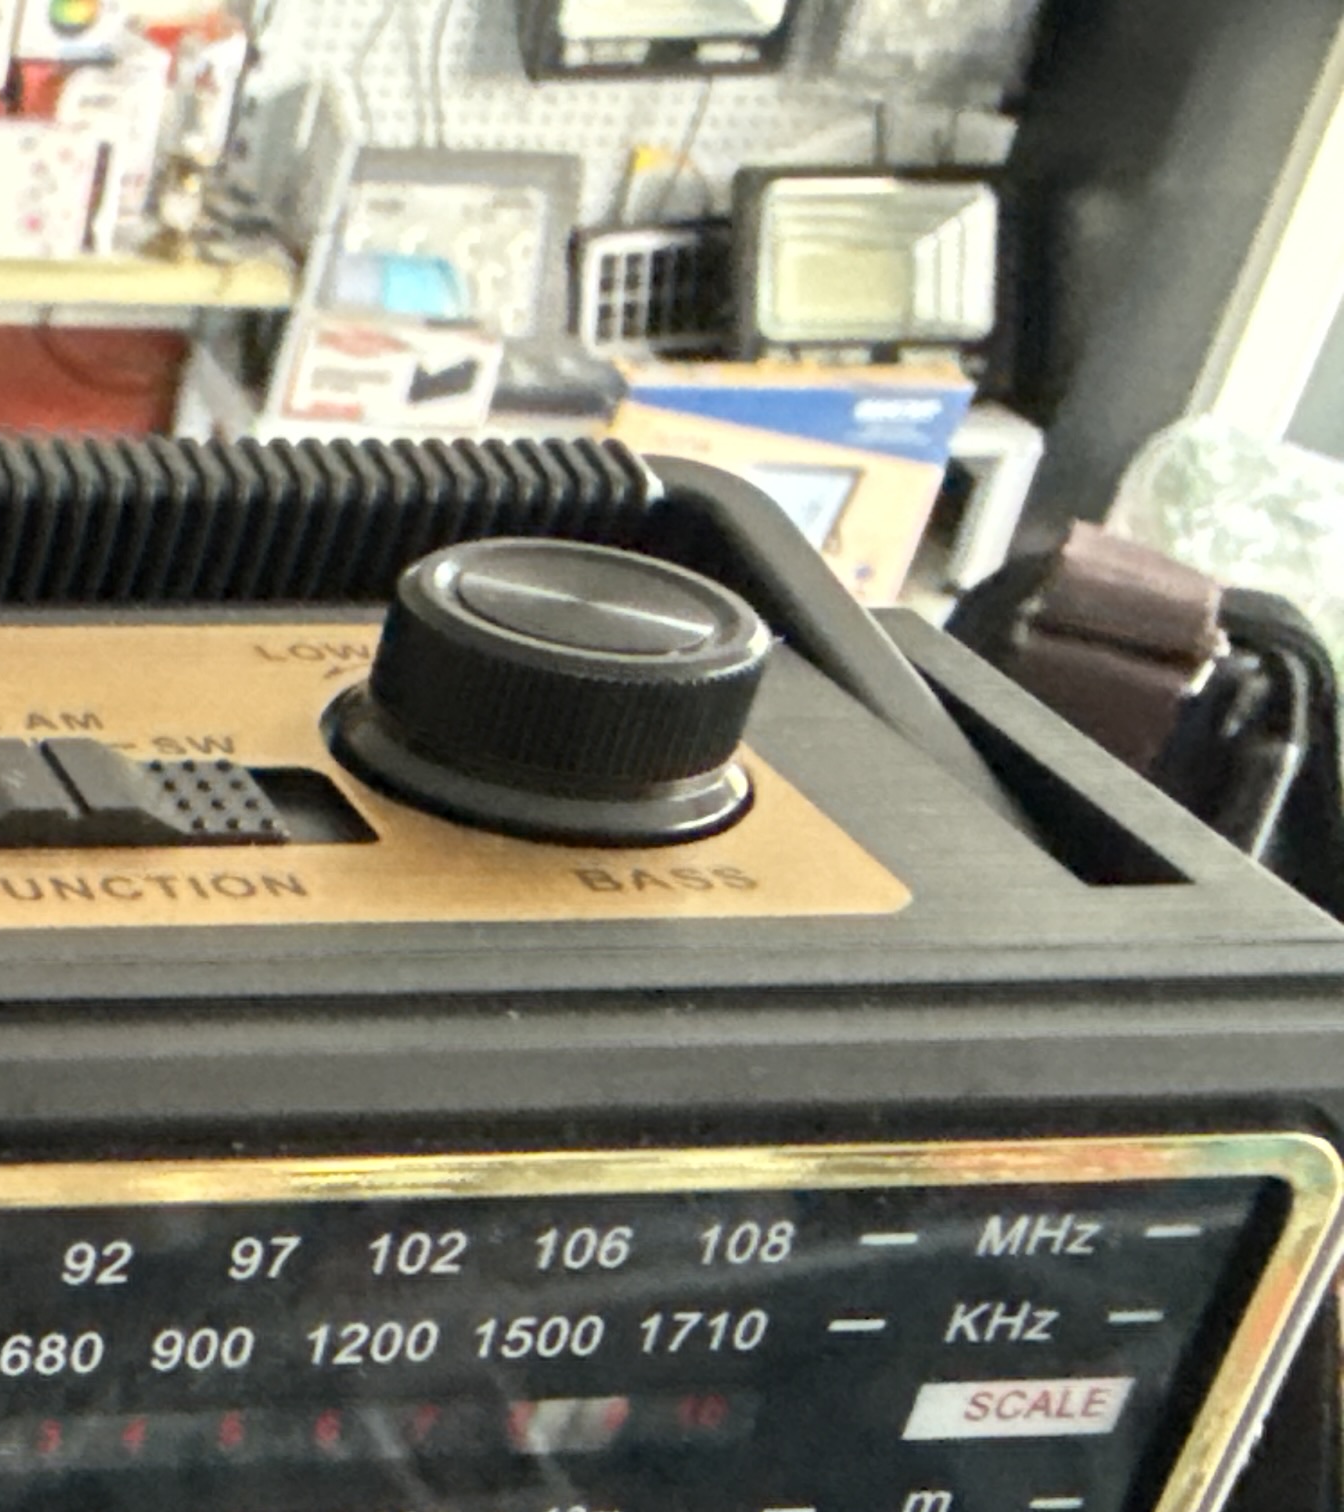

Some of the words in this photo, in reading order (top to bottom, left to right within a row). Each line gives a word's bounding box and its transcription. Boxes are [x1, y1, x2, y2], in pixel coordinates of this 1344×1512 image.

[25, 711, 104, 731] AM
[152, 735, 235, 756] SW
[571, 866, 758, 893] BASS
[62, 1241, 133, 1285] 92
[229, 1236, 301, 1280] 97
[370, 1230, 468, 1275] 102
[537, 1226, 633, 1269] 106
[701, 1220, 795, 1265] 108
[976, 1214, 1103, 1256] MHz
[0, 1332, 104, 1376] 680
[151, 1326, 255, 1371] 900
[308, 1319, 439, 1364] 1200
[476, 1315, 605, 1359] 1500
[641, 1309, 768, 1352] 1710
[945, 1302, 1059, 1343] KHz
[963, 1387, 1113, 1421] SCALE
